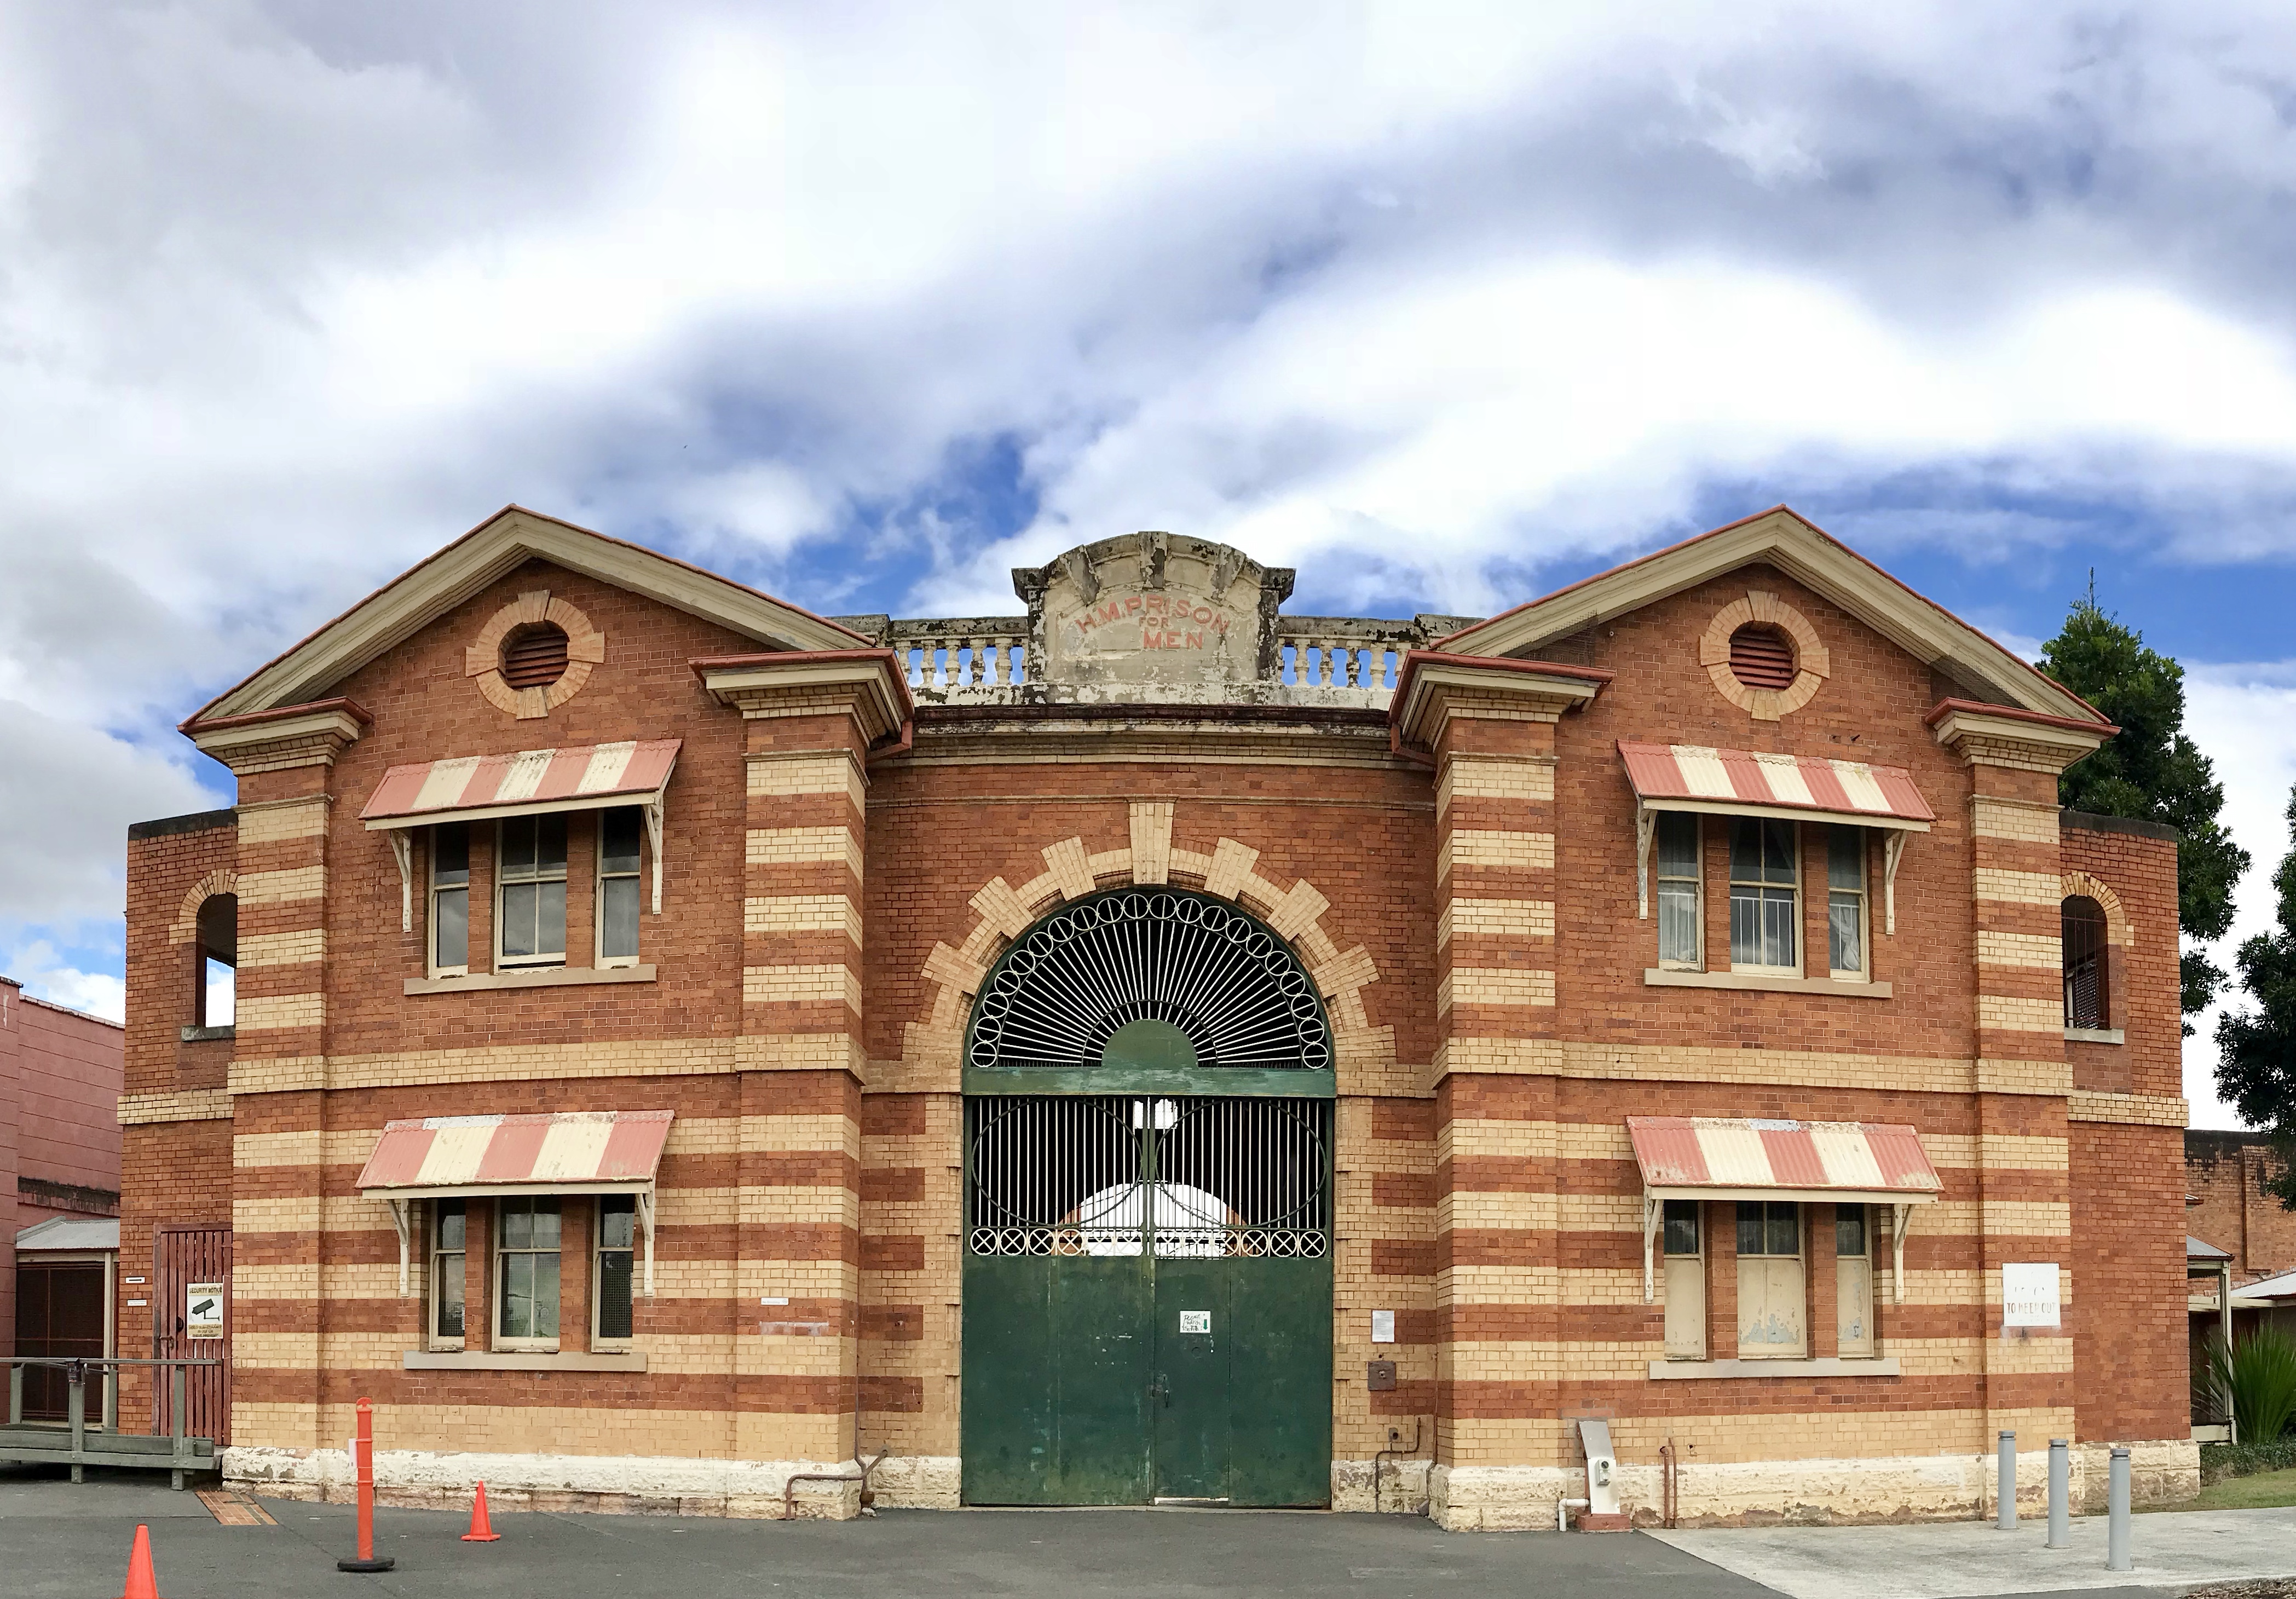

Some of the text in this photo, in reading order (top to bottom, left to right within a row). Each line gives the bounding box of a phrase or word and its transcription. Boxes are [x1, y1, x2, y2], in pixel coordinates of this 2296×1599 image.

[1139, 616, 1169, 628] FOR
[1143, 631, 1203, 649] MEN
[2006, 1302, 2016, 1314] TO
[2041, 1302, 2056, 1313] OUT
